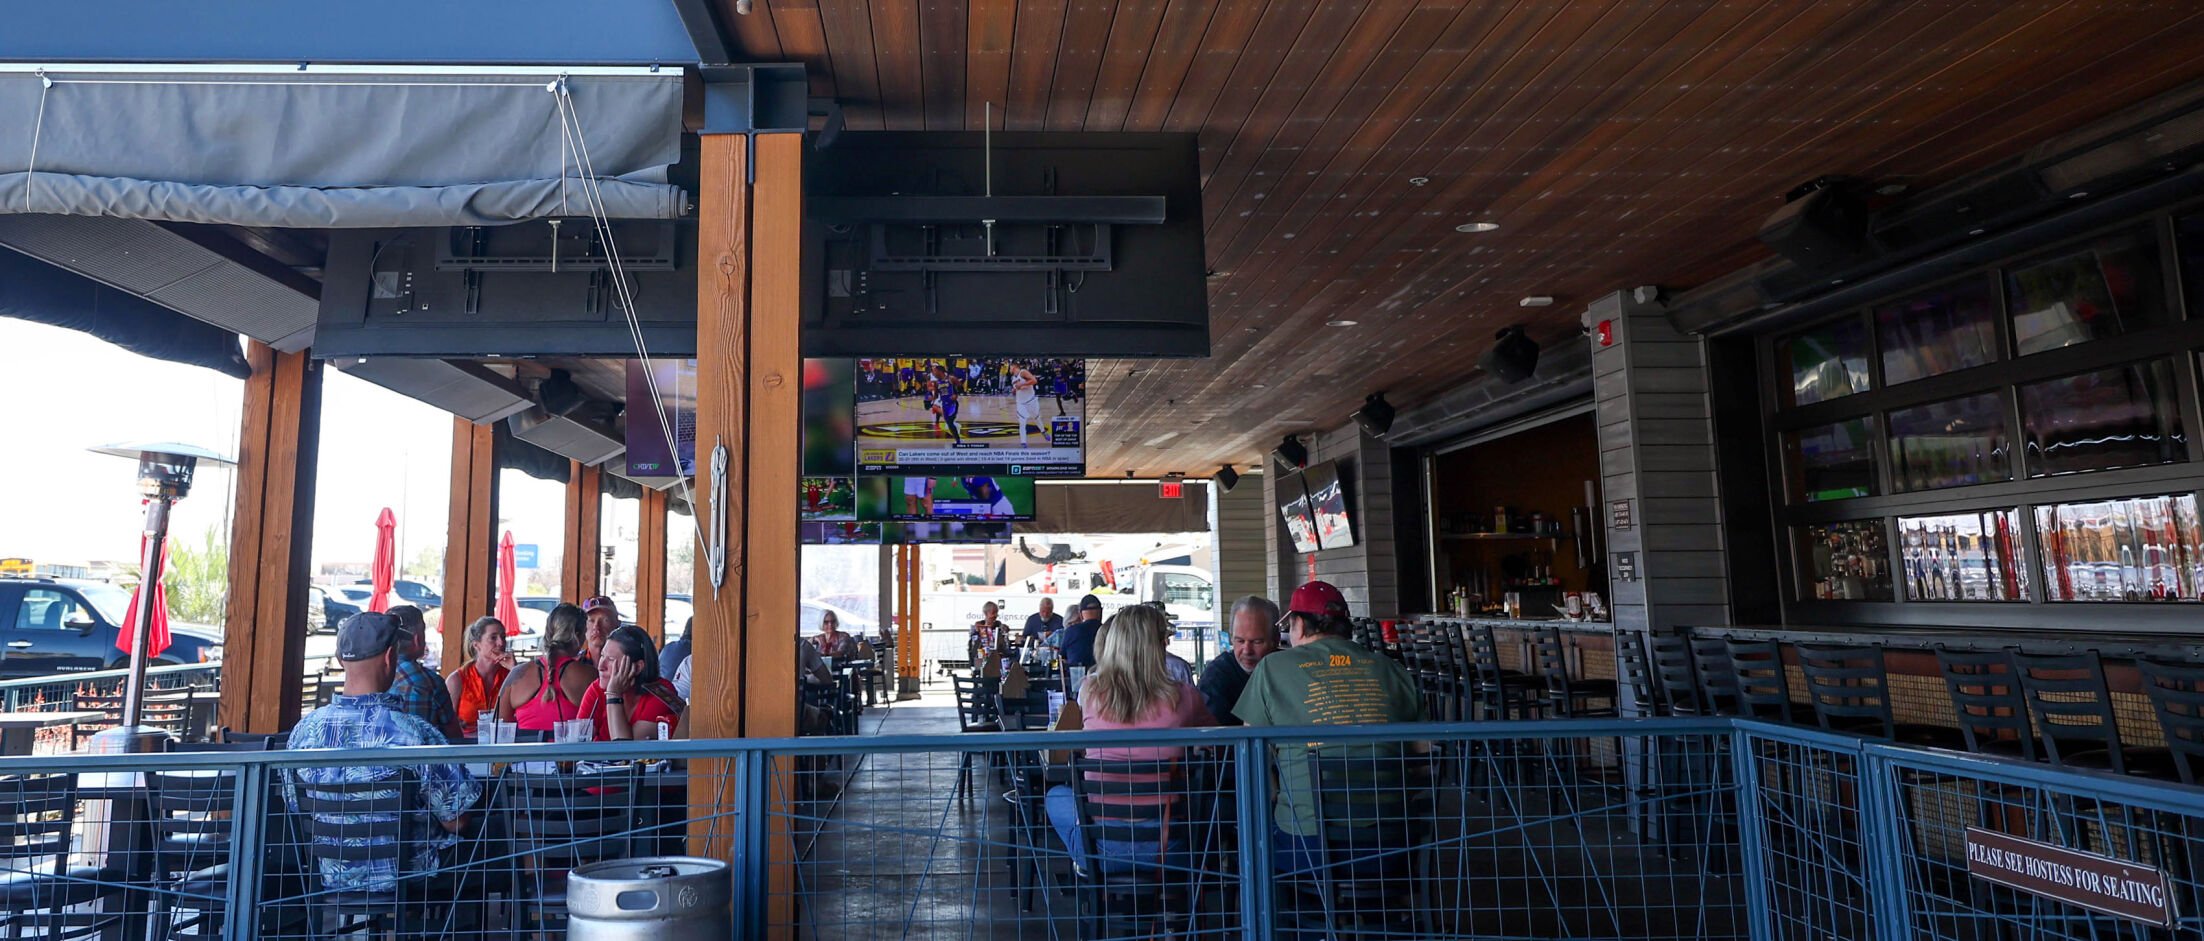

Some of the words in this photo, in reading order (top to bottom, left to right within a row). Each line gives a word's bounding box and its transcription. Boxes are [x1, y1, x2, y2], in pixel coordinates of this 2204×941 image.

[1163, 483, 1180, 497] EXIT
[1330, 655, 1351, 666] 2024
[1968, 842, 2004, 868] PLEASE
[2005, 851, 2024, 873] SEE
[2026, 857, 2073, 886] HOSTESS
[2074, 868, 2101, 893] FOR
[2102, 874, 2162, 908] SEATING
